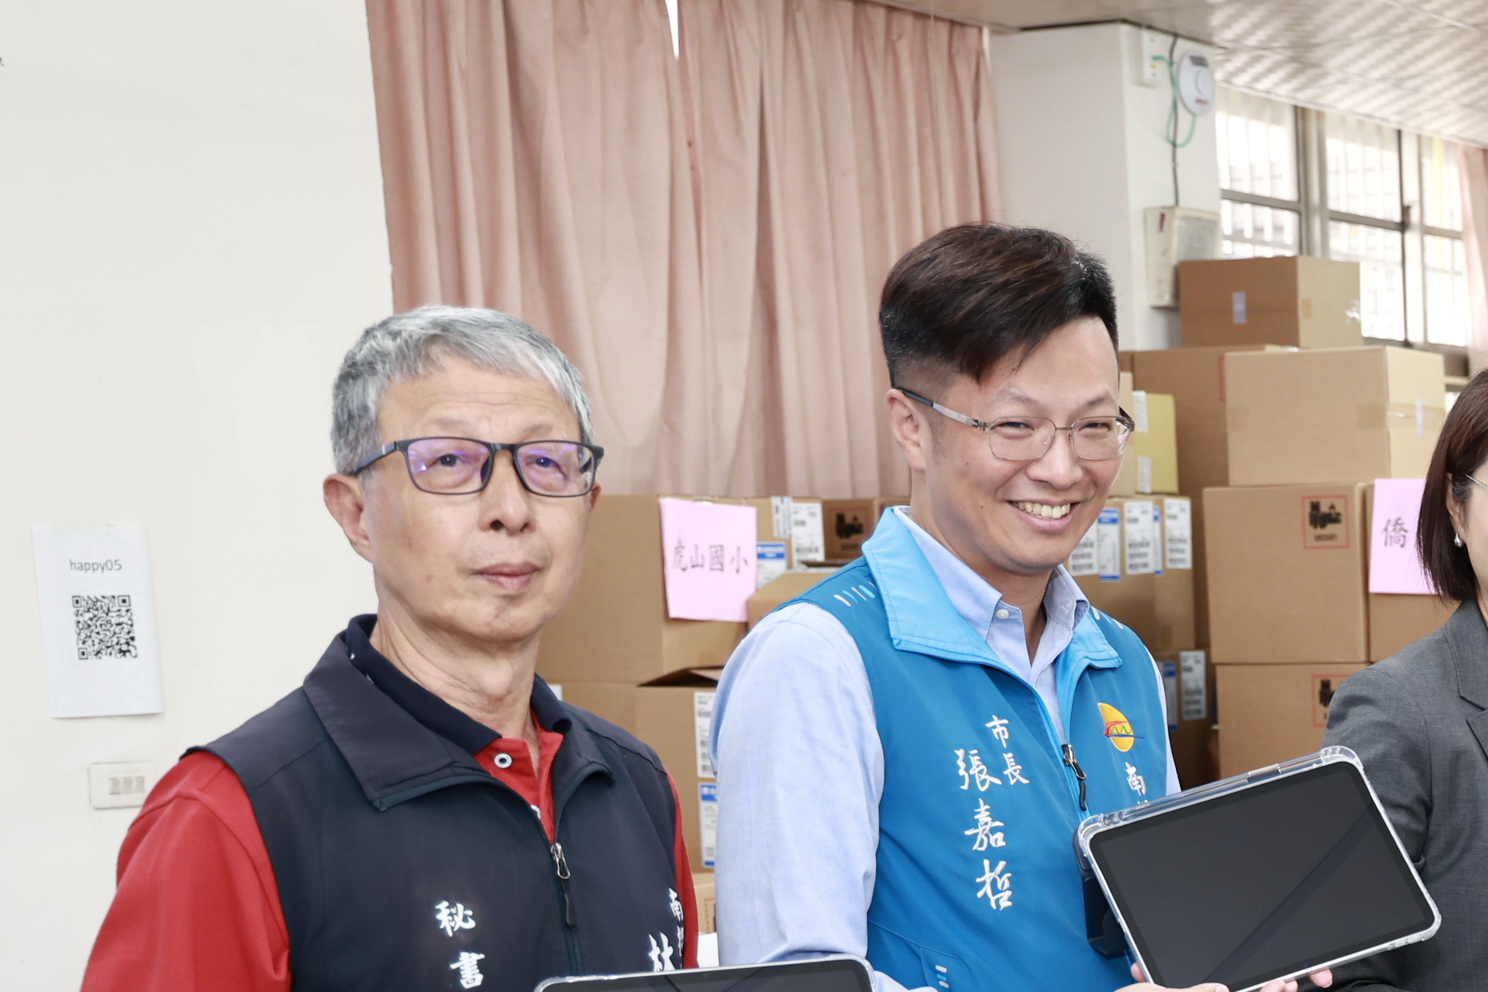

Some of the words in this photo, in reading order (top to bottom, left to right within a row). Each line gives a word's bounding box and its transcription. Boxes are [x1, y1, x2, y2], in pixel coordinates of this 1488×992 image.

[673, 538, 749, 574] 虎山國小
[1381, 516, 1409, 549] 僑
[69, 558, 123, 573] happy05
[985, 714, 1030, 786] 市長
[954, 748, 1014, 911] 張嘉哲
[434, 900, 485, 989] 秘書
